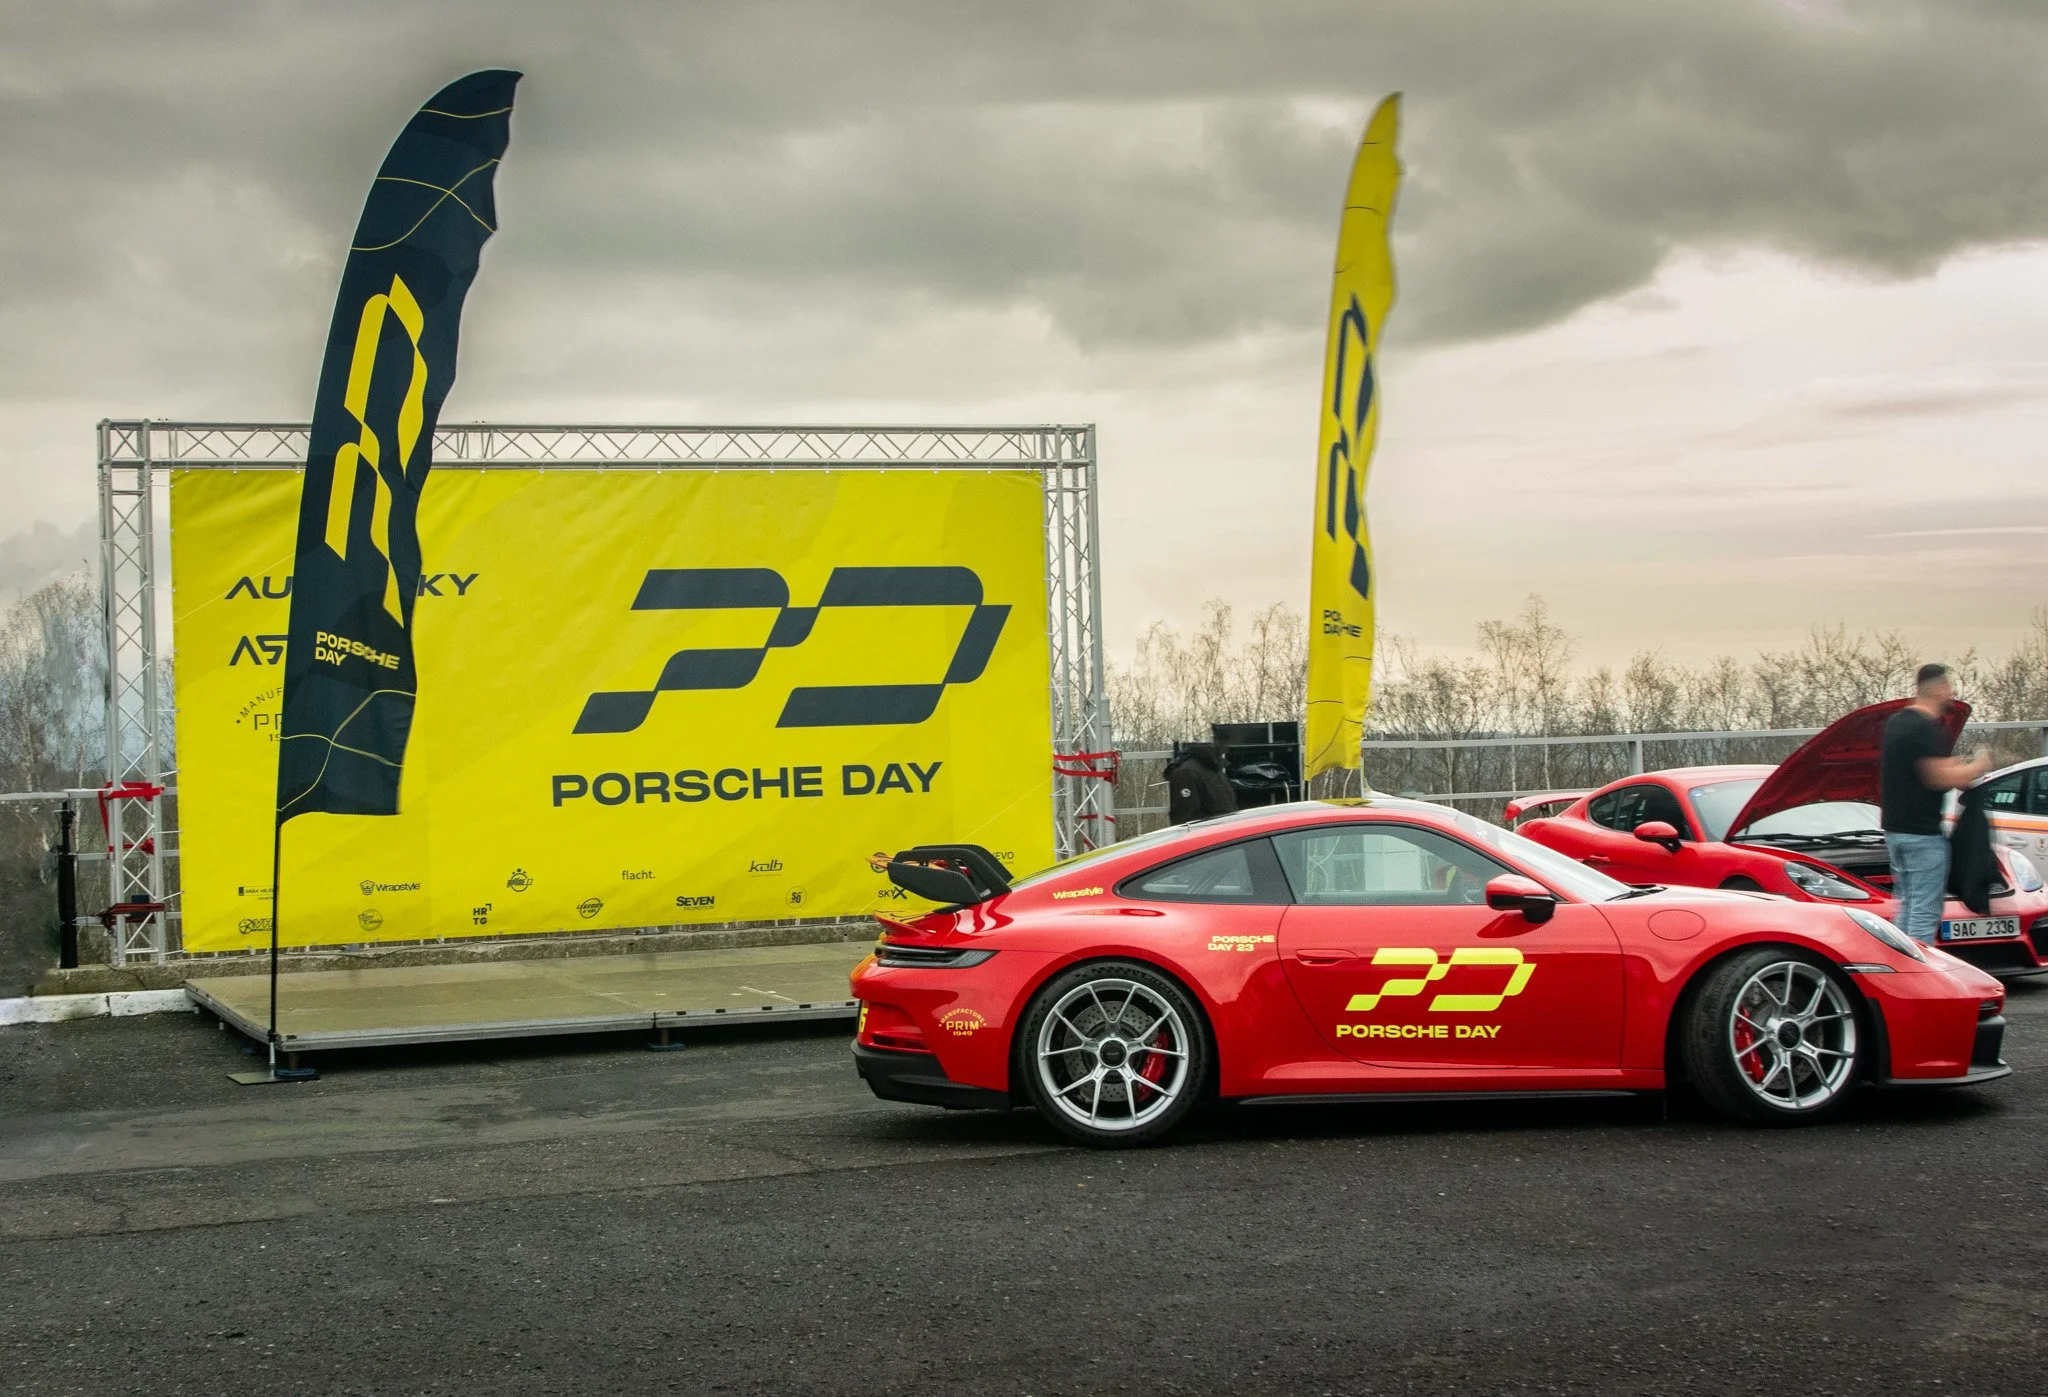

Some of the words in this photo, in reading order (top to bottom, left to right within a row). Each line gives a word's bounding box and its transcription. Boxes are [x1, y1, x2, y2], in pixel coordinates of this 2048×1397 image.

[315, 646, 348, 666] DAY
[552, 766, 825, 807] PORSCHE
[842, 761, 944, 796] DAY
[375, 882, 421, 893] Wrapstyle
[1051, 886, 1104, 901] Wrapstyle
[473, 907, 488, 916] HR
[473, 916, 488, 926] TG
[1953, 922, 1977, 937] 9AC
[1986, 919, 2015, 935] 2336
[1212, 934, 1276, 944] PORSCHE
[1207, 942, 1234, 952] DAY
[1236, 943, 1255, 952] 23
[940, 1007, 986, 1025] MANUFACTURE
[946, 1020, 980, 1031] PRIM
[1336, 1024, 1448, 1039] PORSCHE
[1455, 1024, 1502, 1039] DAY
